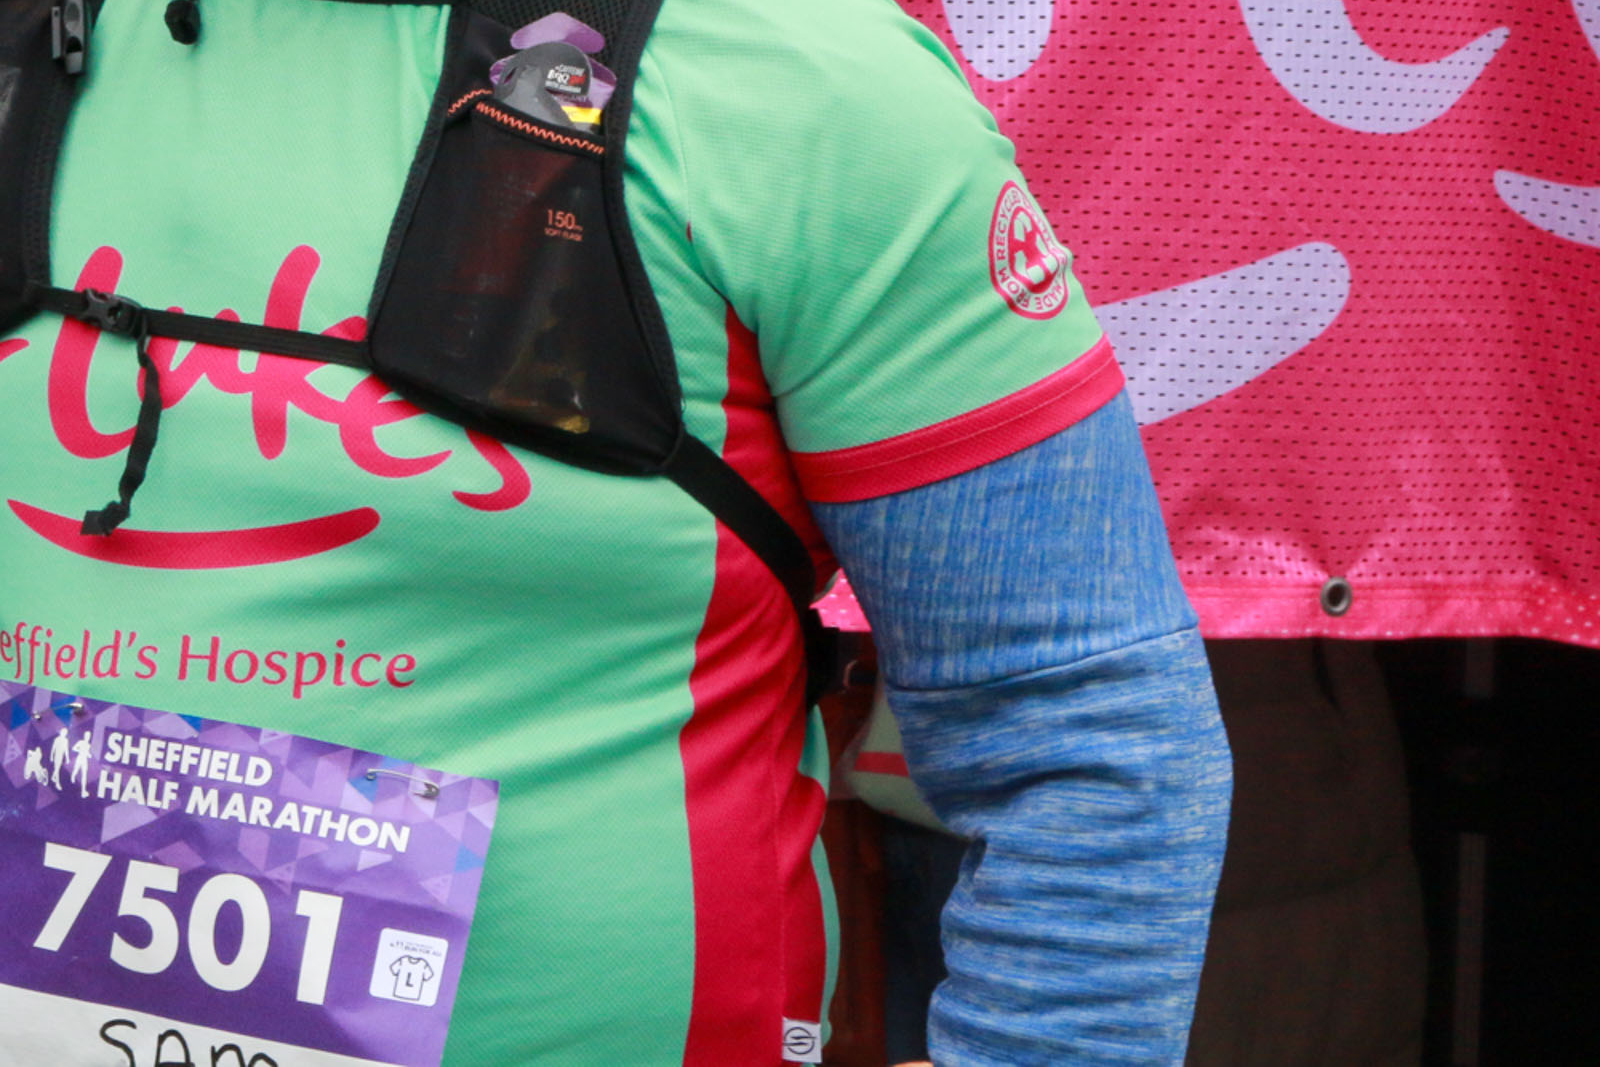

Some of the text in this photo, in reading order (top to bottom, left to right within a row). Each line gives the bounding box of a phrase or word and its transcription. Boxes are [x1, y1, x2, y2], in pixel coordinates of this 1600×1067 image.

[177, 634, 418, 699] Hospice
[104, 732, 273, 787] SHEFFIELD
[96, 768, 410, 853] HALF MARATHON
[33, 841, 344, 1006] 7501
[405, 971, 414, 988] L
